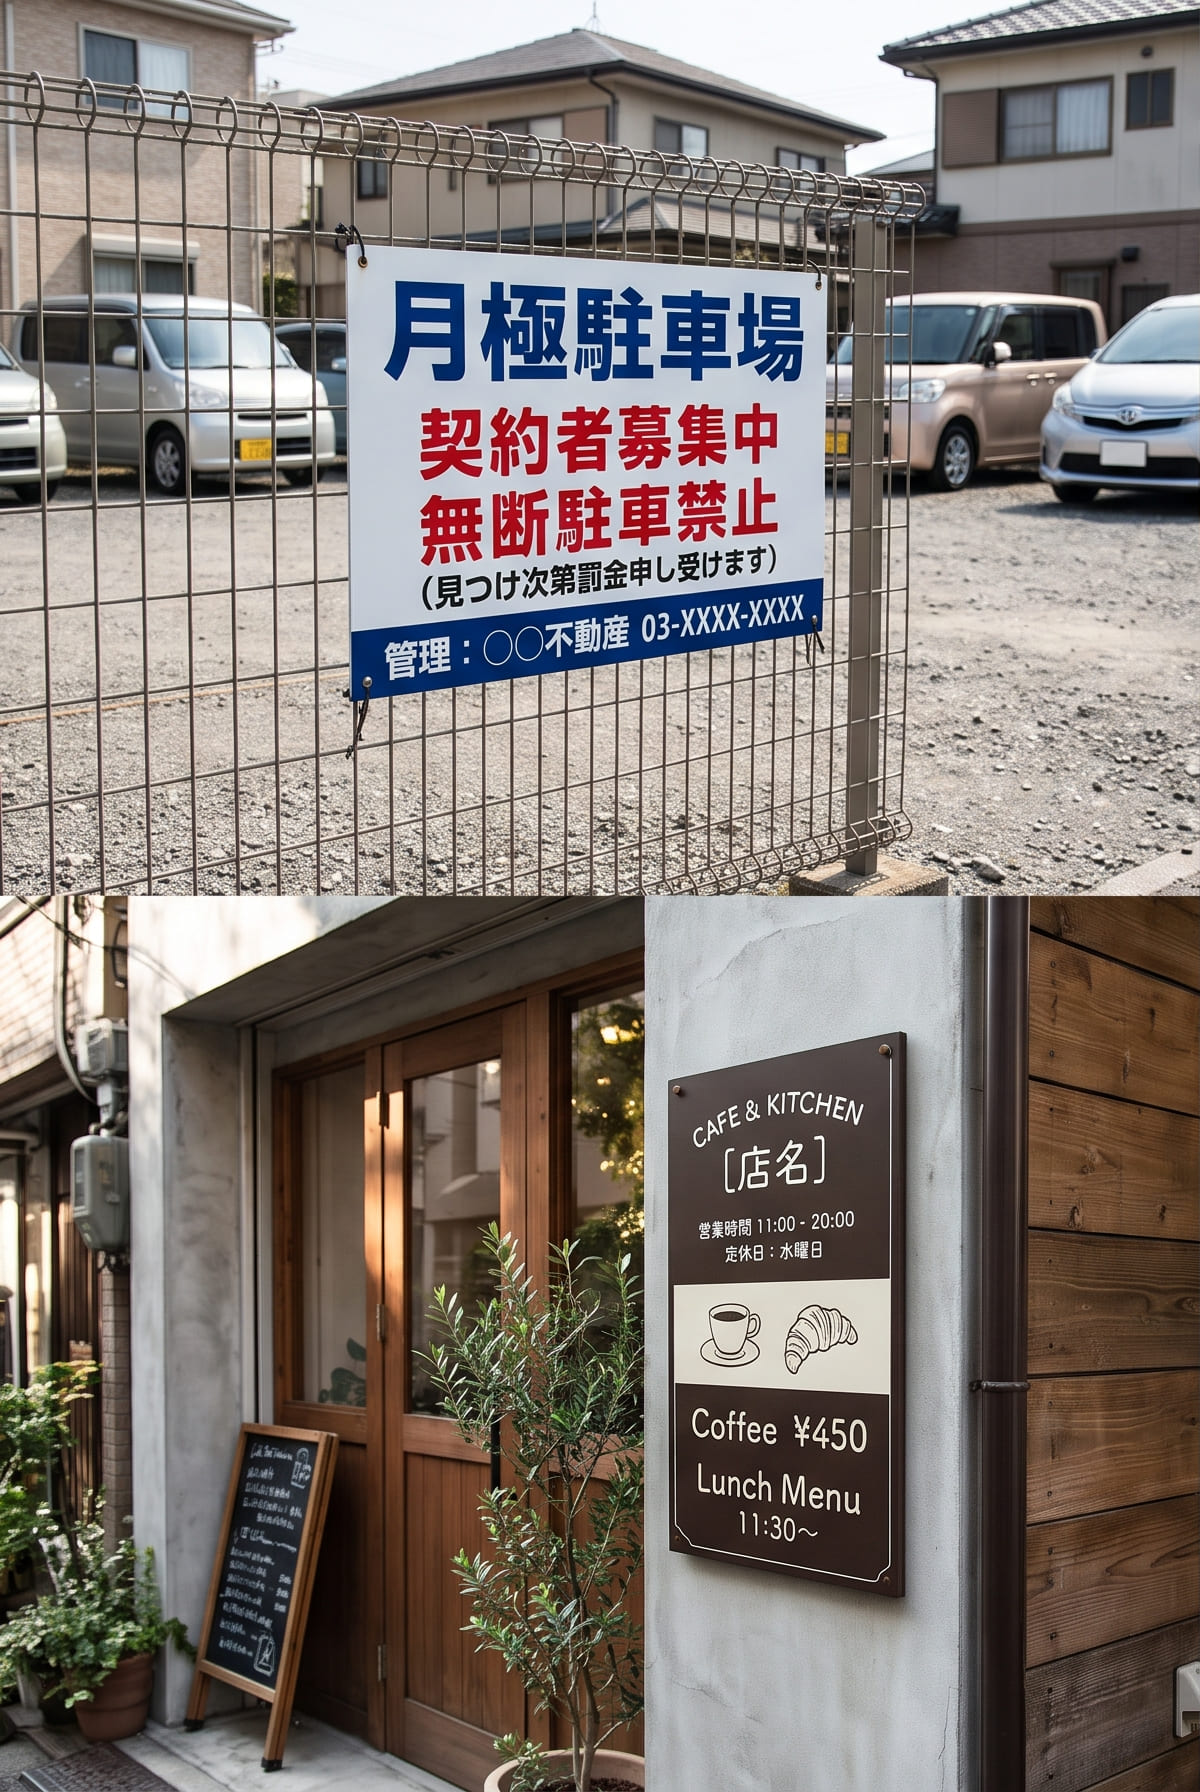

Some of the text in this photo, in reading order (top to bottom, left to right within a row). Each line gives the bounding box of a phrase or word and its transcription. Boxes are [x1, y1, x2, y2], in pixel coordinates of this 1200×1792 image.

[384, 280, 804, 382] 月極駐車場
[419, 402, 779, 481] 契約者募集中
[419, 477, 779, 567] 無断駐車禁止
[641, 593, 805, 643] 03-XXXX-XXXX
[693, 1091, 864, 1148] CAFE & KITCHEN
[698, 1218, 752, 1240] 営業時間
[757, 1215, 796, 1234] 11:00
[811, 1210, 855, 1230] 20:00
[691, 1407, 868, 1453] Coffee ¥450
[697, 1462, 861, 1515] Lunch Menu
